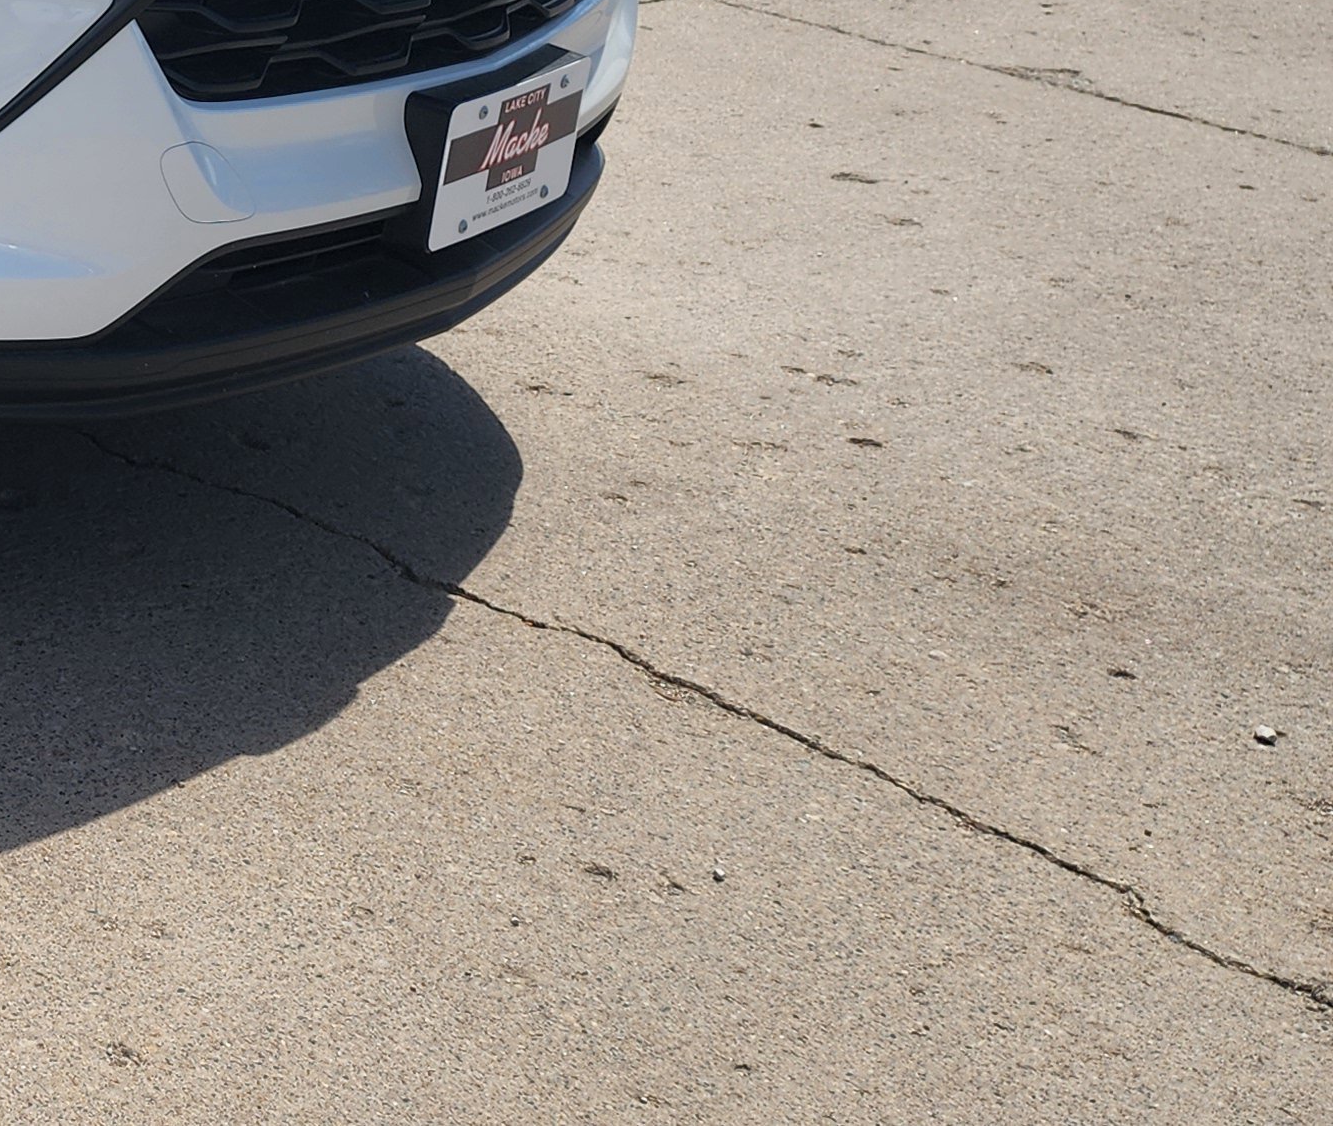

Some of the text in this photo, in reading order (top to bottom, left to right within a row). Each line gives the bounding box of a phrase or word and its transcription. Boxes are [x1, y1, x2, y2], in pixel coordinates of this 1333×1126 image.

[505, 87, 546, 113] LAKE CITY
[478, 106, 550, 172] Macke
[501, 165, 523, 183] IOWA
